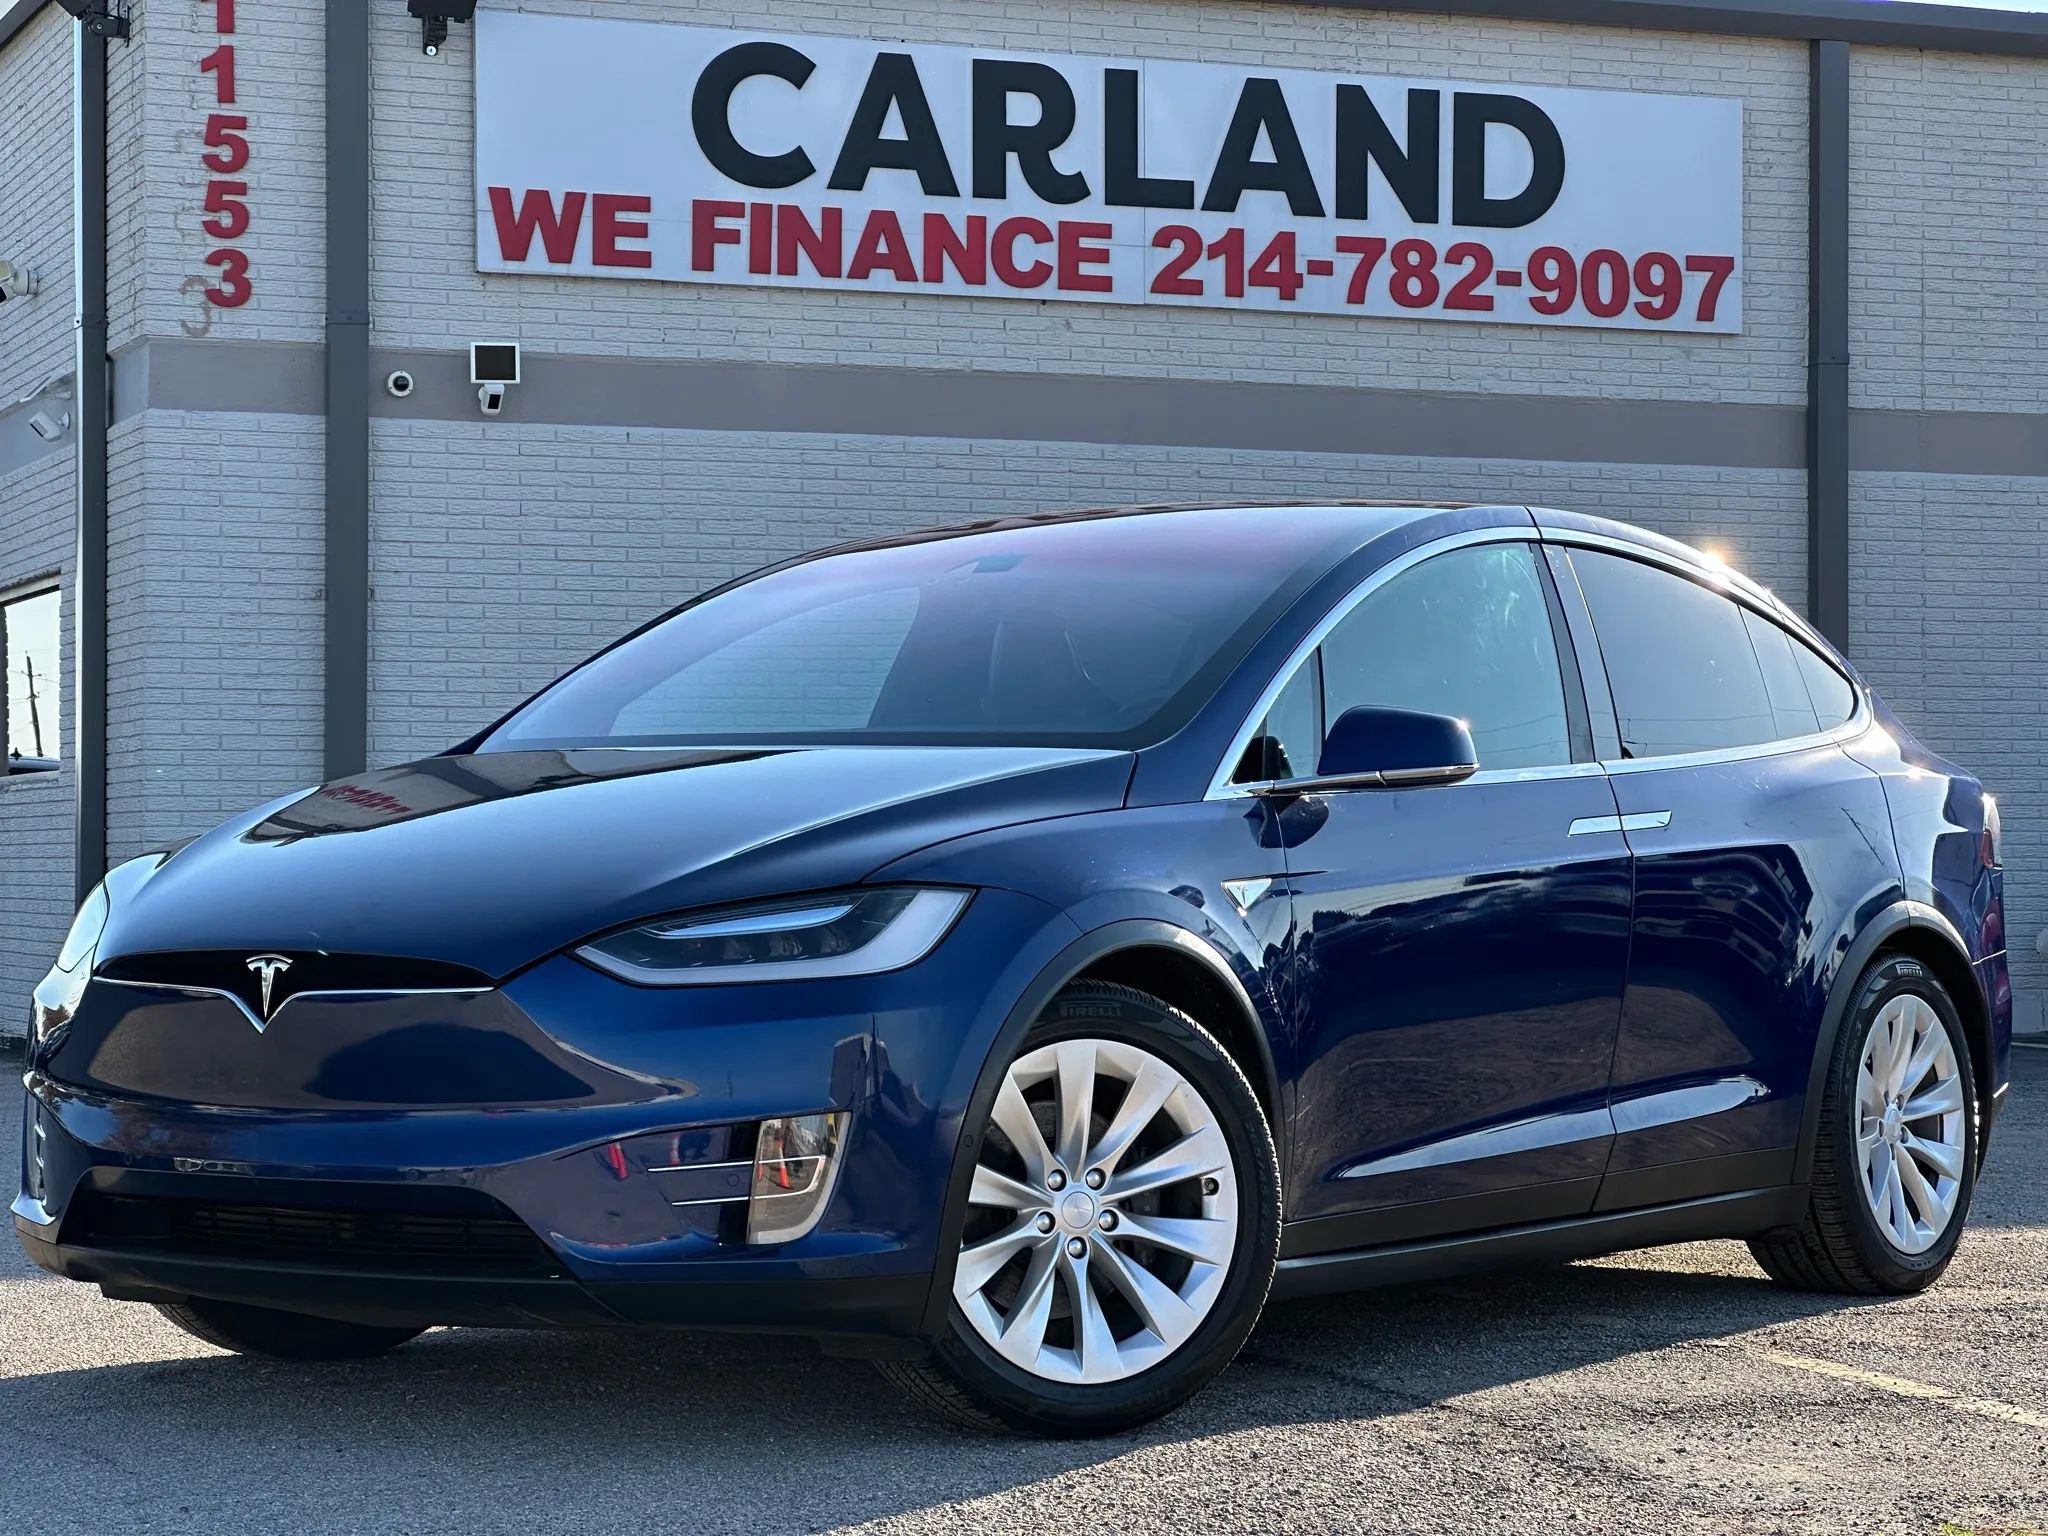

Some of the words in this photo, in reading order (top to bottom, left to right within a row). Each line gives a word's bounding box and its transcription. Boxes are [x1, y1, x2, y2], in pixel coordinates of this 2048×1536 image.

[691, 41, 1566, 229] CARLAND
[487, 187, 652, 268] WE
[693, 199, 1112, 291] FINANCE
[1151, 225, 1735, 322] 214-782-9097
[1060, 1001, 1121, 1017] PIRELLI
